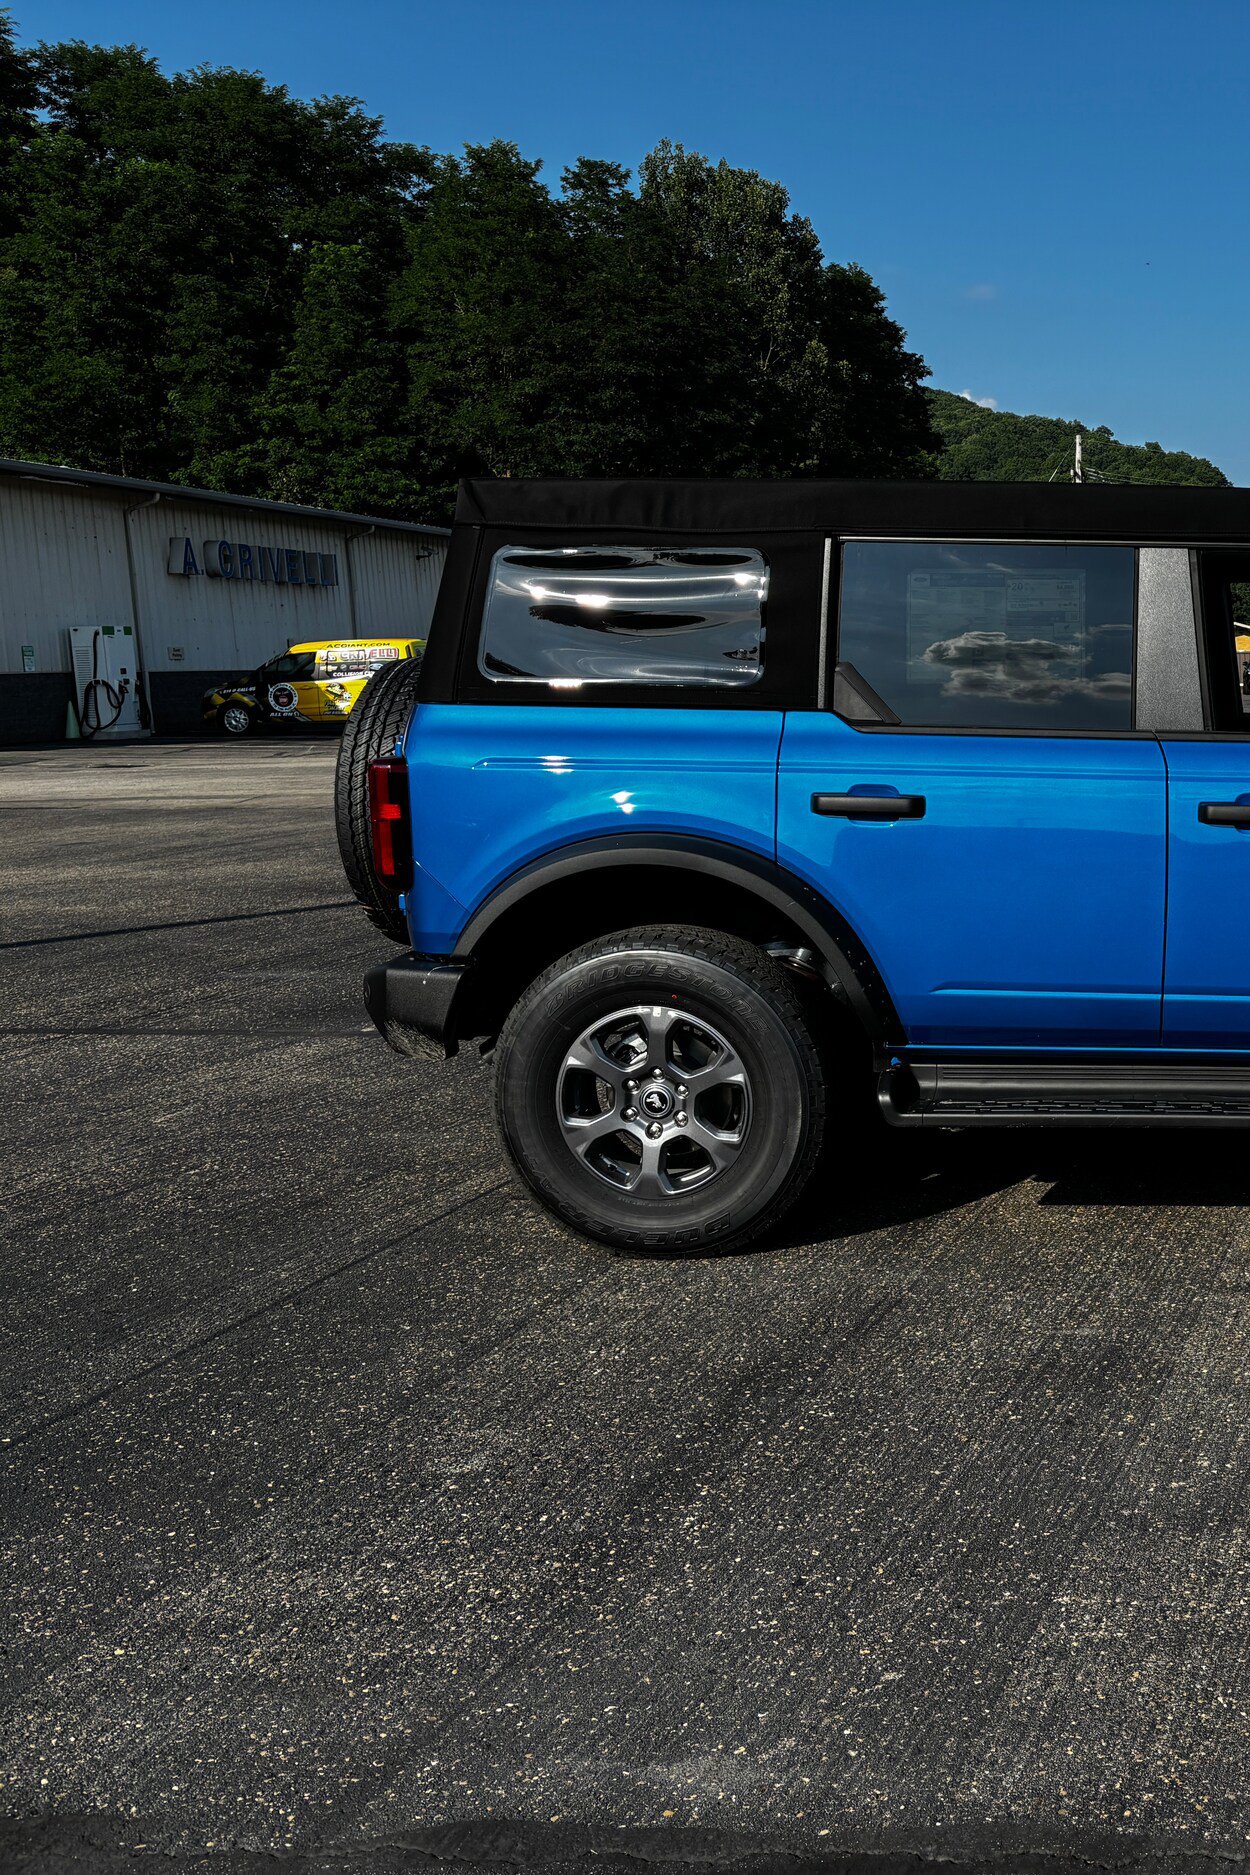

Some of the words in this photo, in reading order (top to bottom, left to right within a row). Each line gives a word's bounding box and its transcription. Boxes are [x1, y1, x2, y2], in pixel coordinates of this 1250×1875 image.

[218, 540, 339, 586] CRIVELLI
[544, 960, 771, 1033] BRIDGESTONE
[557, 1197, 735, 1247] DUELER
